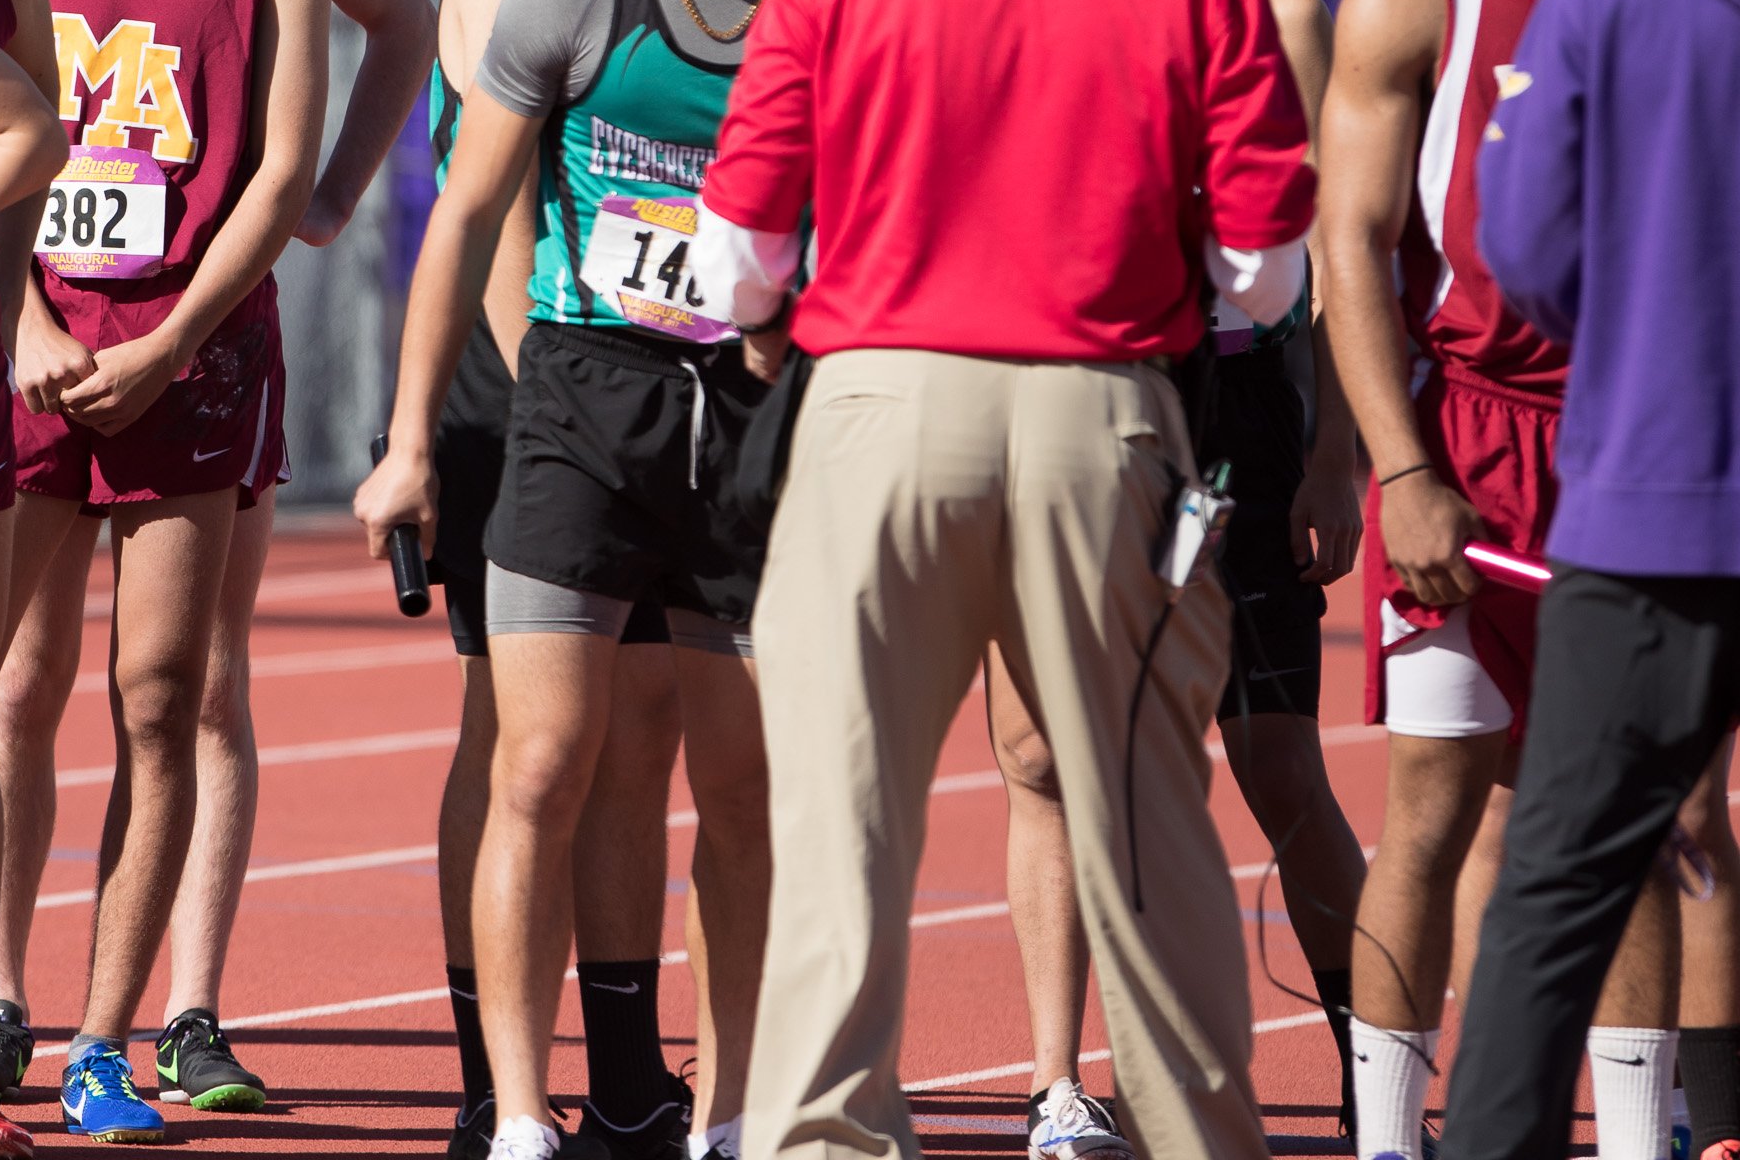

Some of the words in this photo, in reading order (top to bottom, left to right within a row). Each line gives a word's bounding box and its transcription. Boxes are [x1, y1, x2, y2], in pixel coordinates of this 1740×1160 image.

[60, 156, 140, 175] stBuster
[43, 187, 128, 249] 382
[47, 253, 119, 266] INAUGURAL
[56, 264, 79, 272] MARCH
[87, 264, 104, 272] 2017
